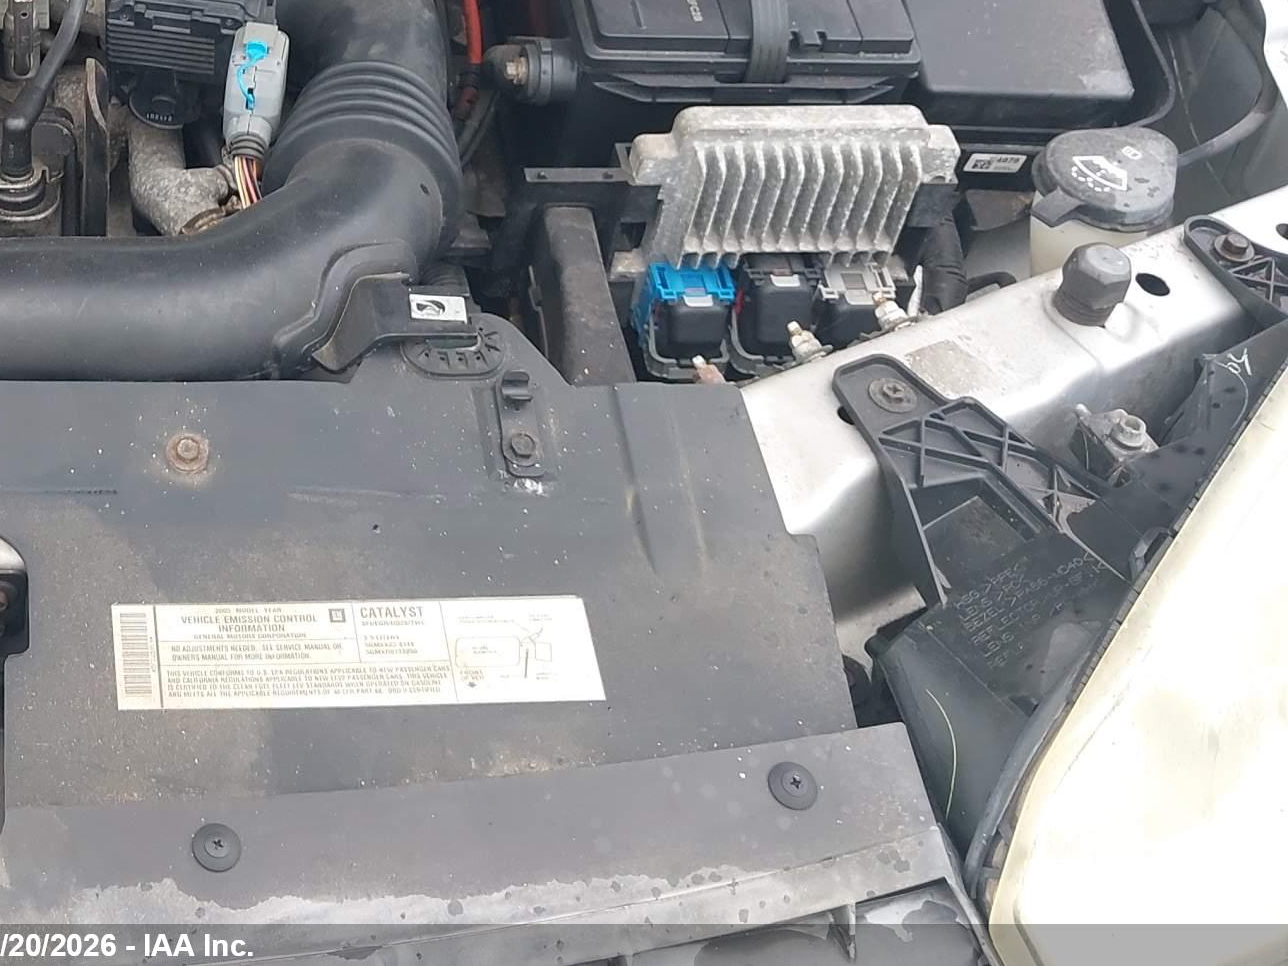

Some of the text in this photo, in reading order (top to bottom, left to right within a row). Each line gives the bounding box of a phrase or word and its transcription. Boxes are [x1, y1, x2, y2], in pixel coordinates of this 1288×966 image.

[360, 606, 424, 619] CATALYST
[181, 616, 220, 624] VEHICLE
[224, 615, 271, 624] EMISSION
[218, 624, 285, 632] INFORMATION
